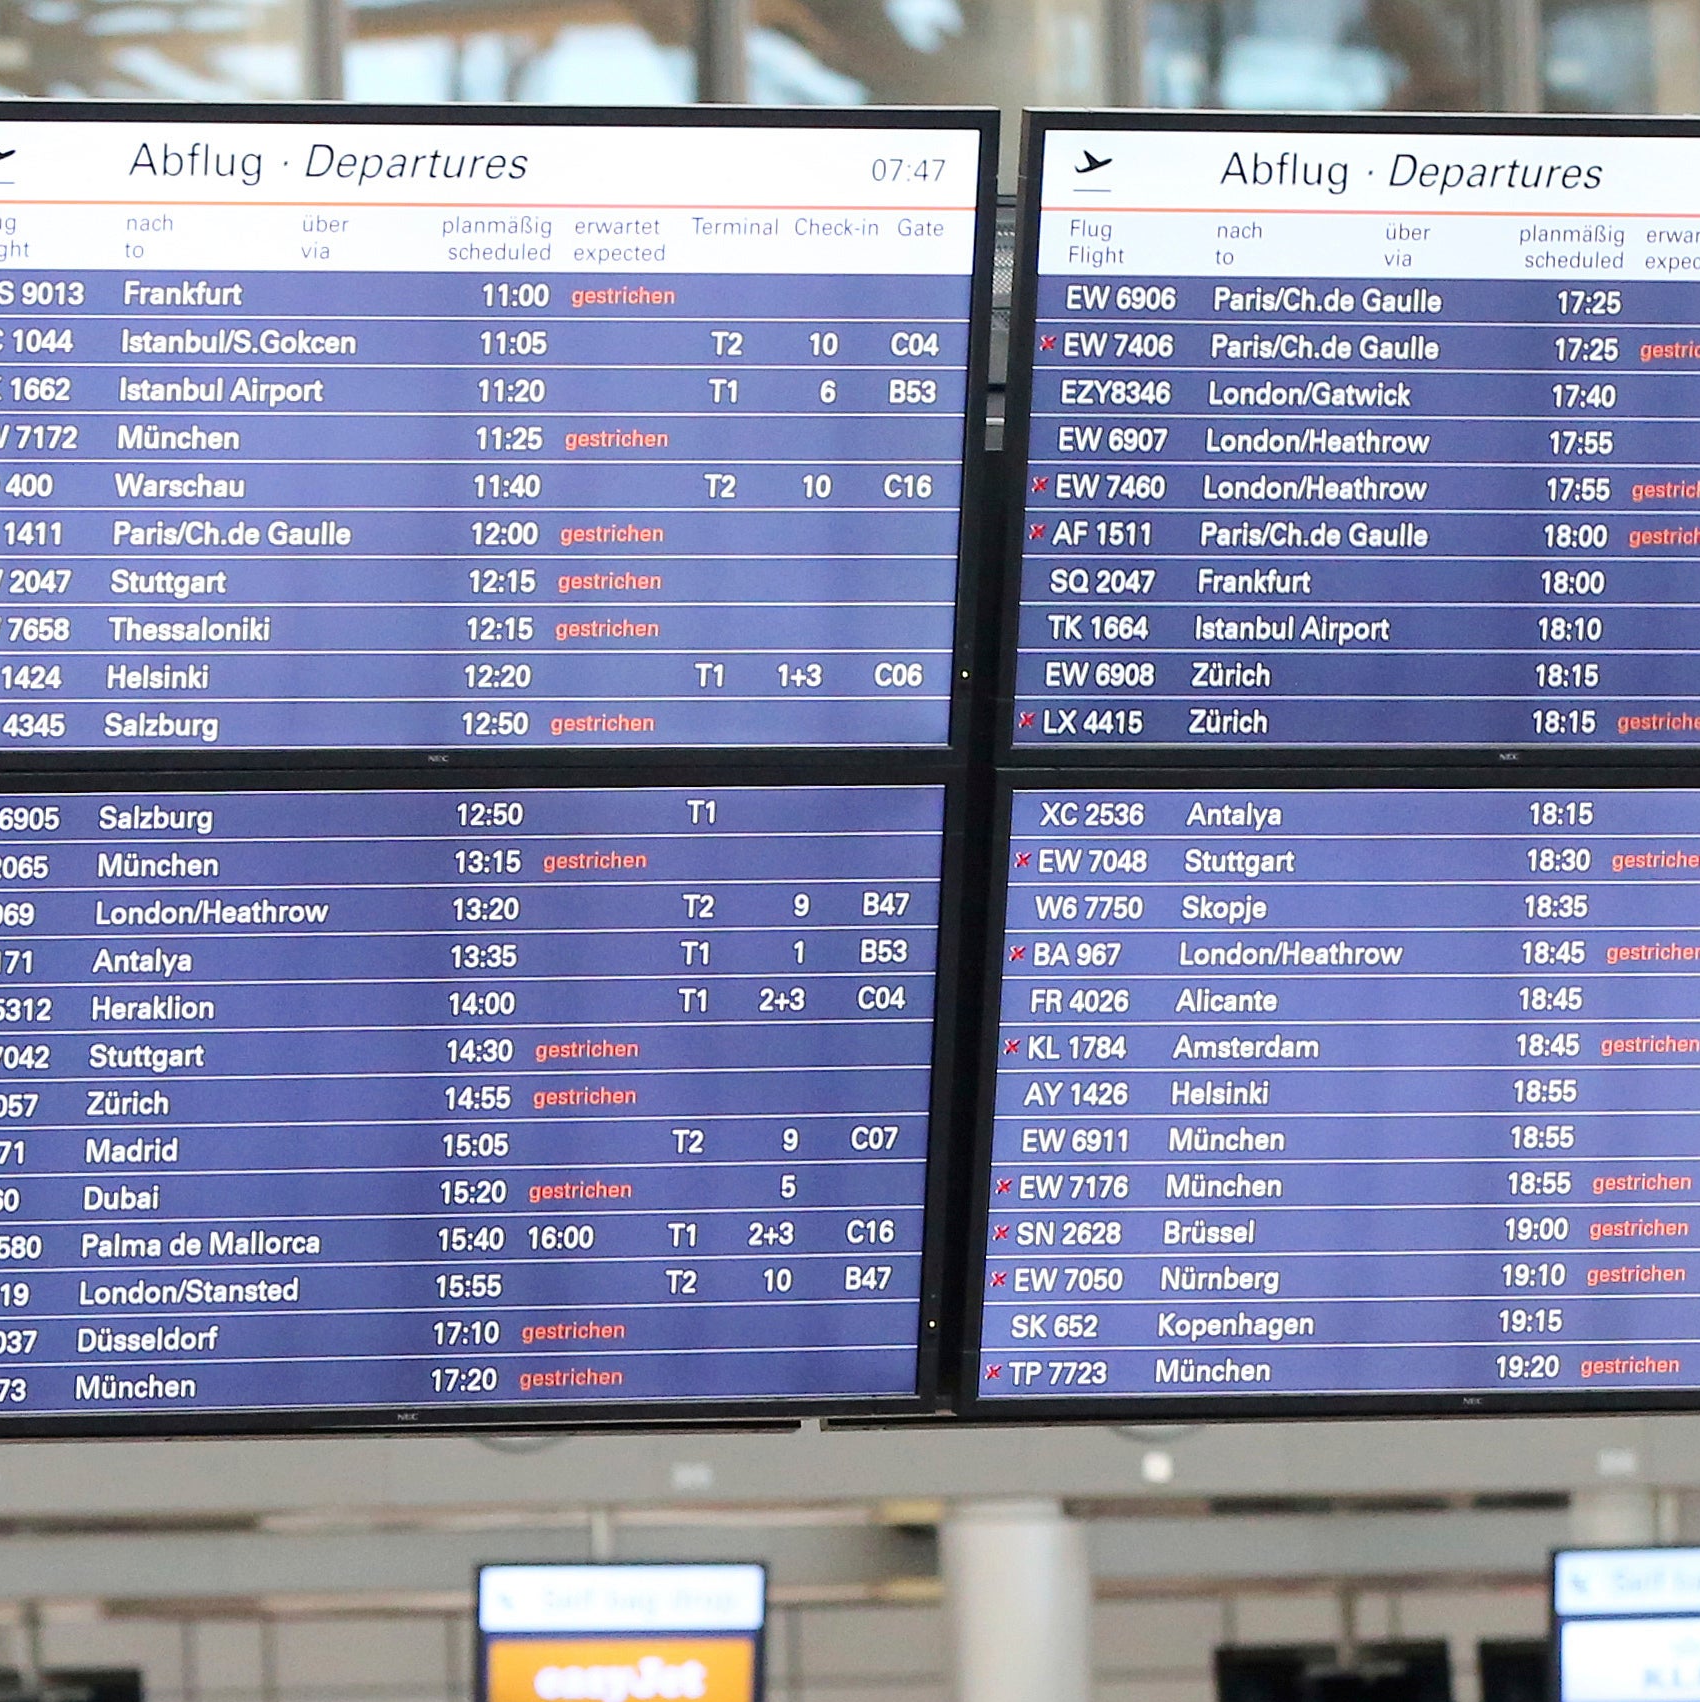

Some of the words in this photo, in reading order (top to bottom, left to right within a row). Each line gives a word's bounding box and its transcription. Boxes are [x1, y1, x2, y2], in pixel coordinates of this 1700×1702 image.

[12, 328, 74, 353] 1044
[121, 328, 356, 354] Istanbul/S.Gokcen
[480, 331, 547, 355] 11:05
[710, 331, 743, 356] T2
[809, 332, 838, 356] 10
[891, 332, 940, 356] C04
[1061, 379, 1171, 405] EZY8346
[1209, 380, 1411, 407] London/Gatwick
[1552, 384, 1616, 408] 17:40
[96, 899, 329, 925] London/Heathrow
[453, 896, 519, 921] 13:20
[682, 894, 714, 918] T2
[794, 893, 810, 917] 9
[863, 892, 910, 916] B47
[1011, 1314, 1048, 1338] SK
[1053, 1314, 1098, 1338] 652
[1158, 1311, 1314, 1342] Kopenhagen
[1499, 1308, 1563, 1333] 19:15
